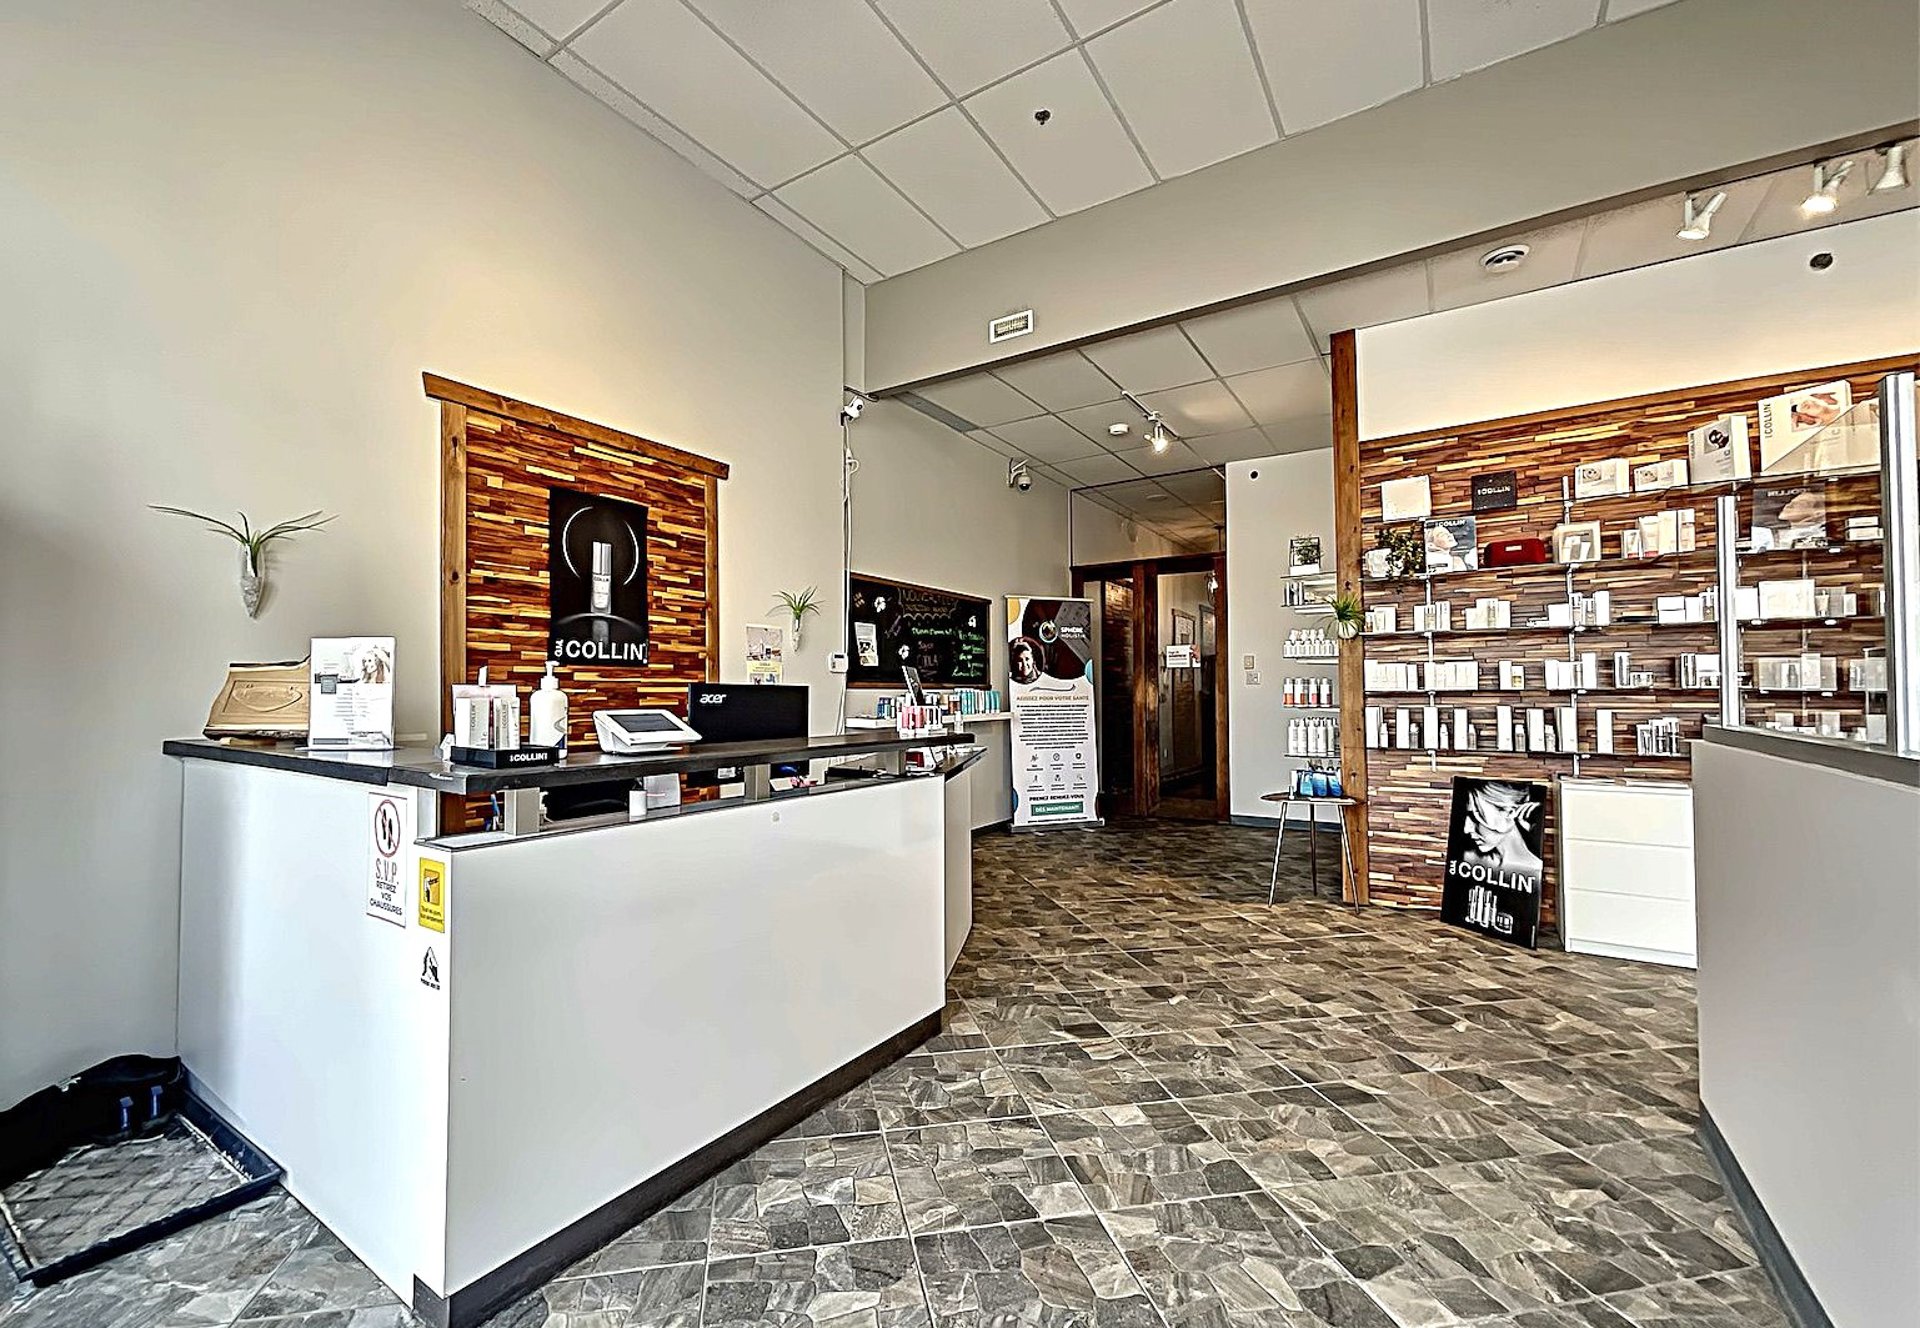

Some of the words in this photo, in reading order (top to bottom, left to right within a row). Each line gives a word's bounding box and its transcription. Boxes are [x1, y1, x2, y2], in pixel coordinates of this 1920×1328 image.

[1762, 403, 1773, 434] COLLIN
[565, 639, 643, 661] COLLIN
[700, 693, 727, 703] acer
[375, 857, 400, 885] S.V.P.
[1458, 861, 1533, 894] COLLIN
[376, 880, 397, 894] RETIREZ
[381, 891, 392, 902] VOS
[369, 897, 403, 916] CHAUSSURES
